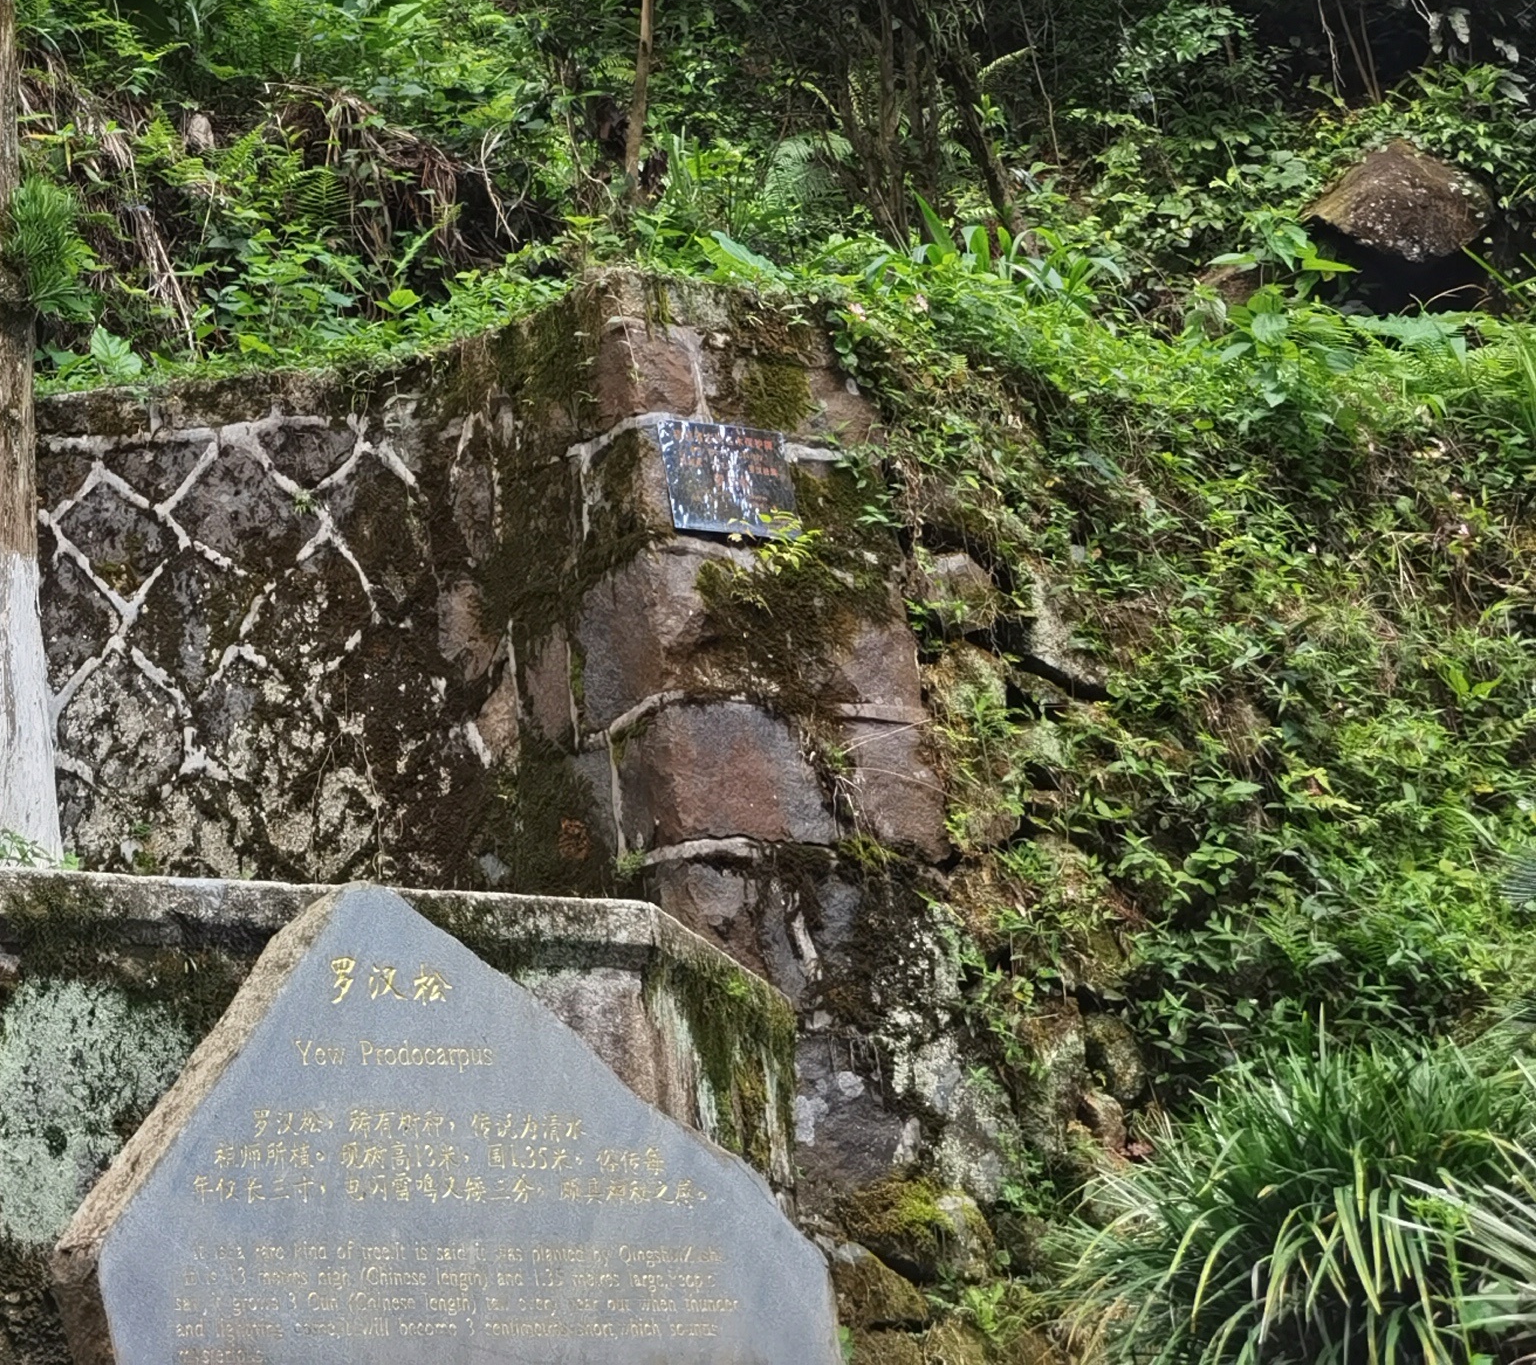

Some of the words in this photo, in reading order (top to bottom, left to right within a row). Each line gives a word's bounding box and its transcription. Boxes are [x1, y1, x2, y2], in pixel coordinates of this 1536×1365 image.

[330, 955, 454, 1007] 罗汉松
[293, 1038, 345, 1067] Yew
[359, 1039, 495, 1074] Prodocarpus
